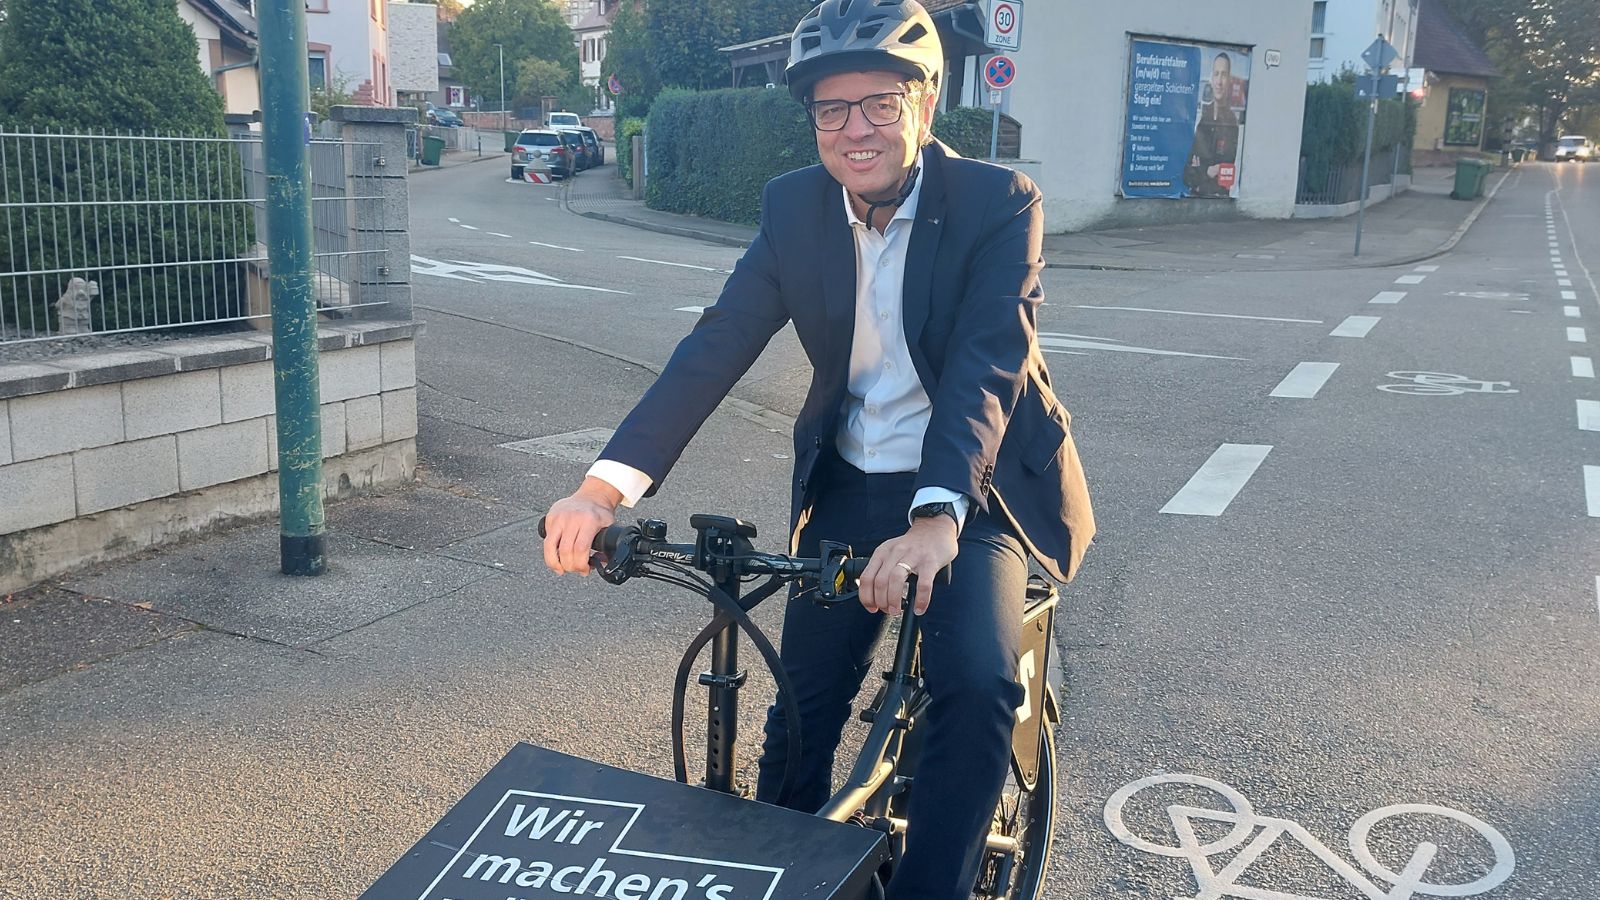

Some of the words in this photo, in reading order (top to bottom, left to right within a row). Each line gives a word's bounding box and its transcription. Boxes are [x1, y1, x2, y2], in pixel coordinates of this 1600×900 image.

[998, 12, 1011, 26] 30
[995, 35, 1011, 44] ZONE
[1136, 53, 1188, 68] Berufskraftfahrer
[1135, 66, 1160, 80] (m/w/d)
[1160, 69, 1171, 80] mit
[1134, 82, 1164, 94] geregelten
[1165, 82, 1195, 94] Schichten?
[1133, 93, 1150, 107] Steig
[1150, 94, 1162, 105] ein!
[504, 804, 603, 845] Wir
